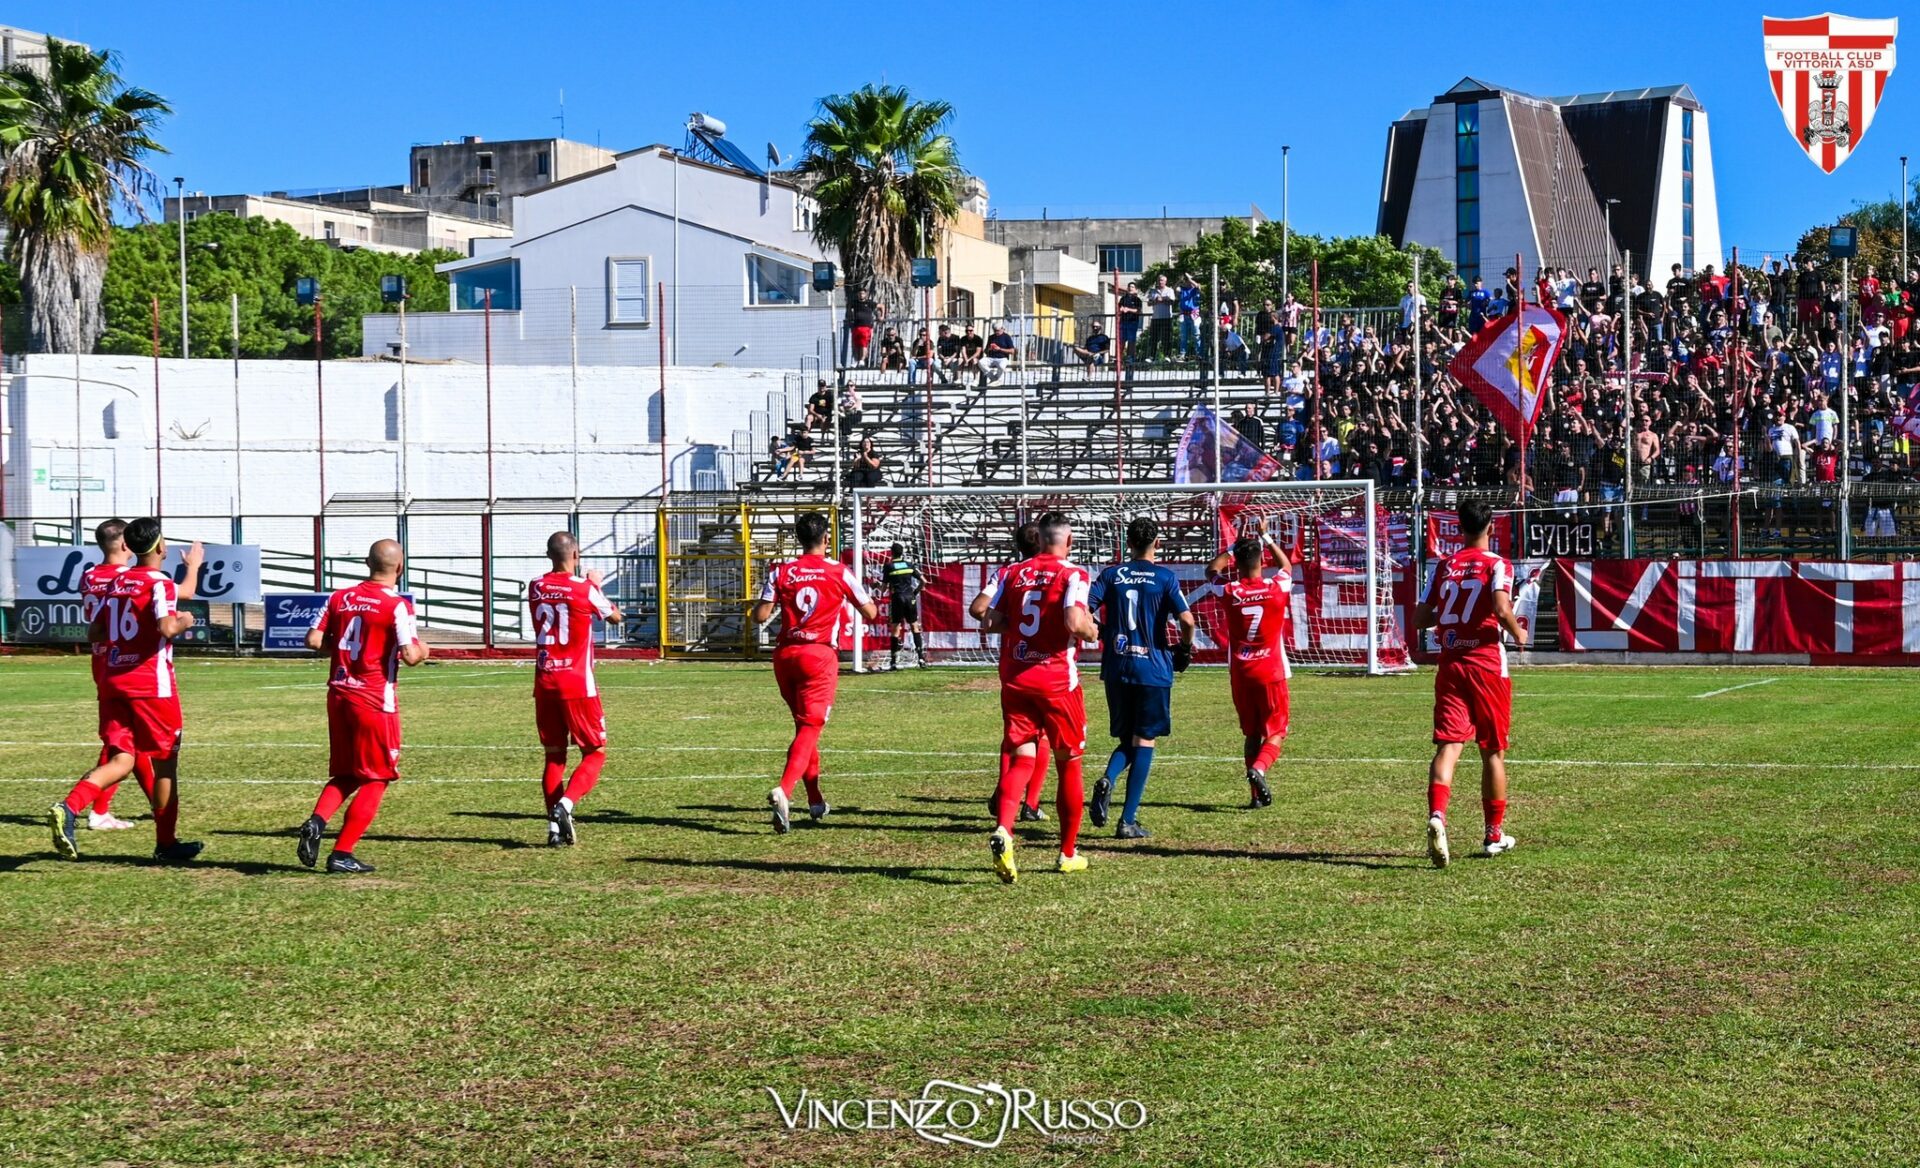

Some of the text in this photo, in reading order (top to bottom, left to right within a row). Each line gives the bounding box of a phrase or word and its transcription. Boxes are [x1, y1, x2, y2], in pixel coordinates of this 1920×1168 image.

[1531, 524, 1592, 556] 97019
[1114, 566, 1148, 585] Sara
[107, 596, 139, 642] 16
[339, 592, 372, 612] Sara
[796, 586, 818, 624] 9
[1019, 590, 1042, 637] 5
[1126, 589, 1139, 631] 1
[1440, 579, 1483, 625] 27
[338, 615, 362, 661] 4
[535, 602, 569, 645] 21
[1241, 605, 1264, 642] 7
